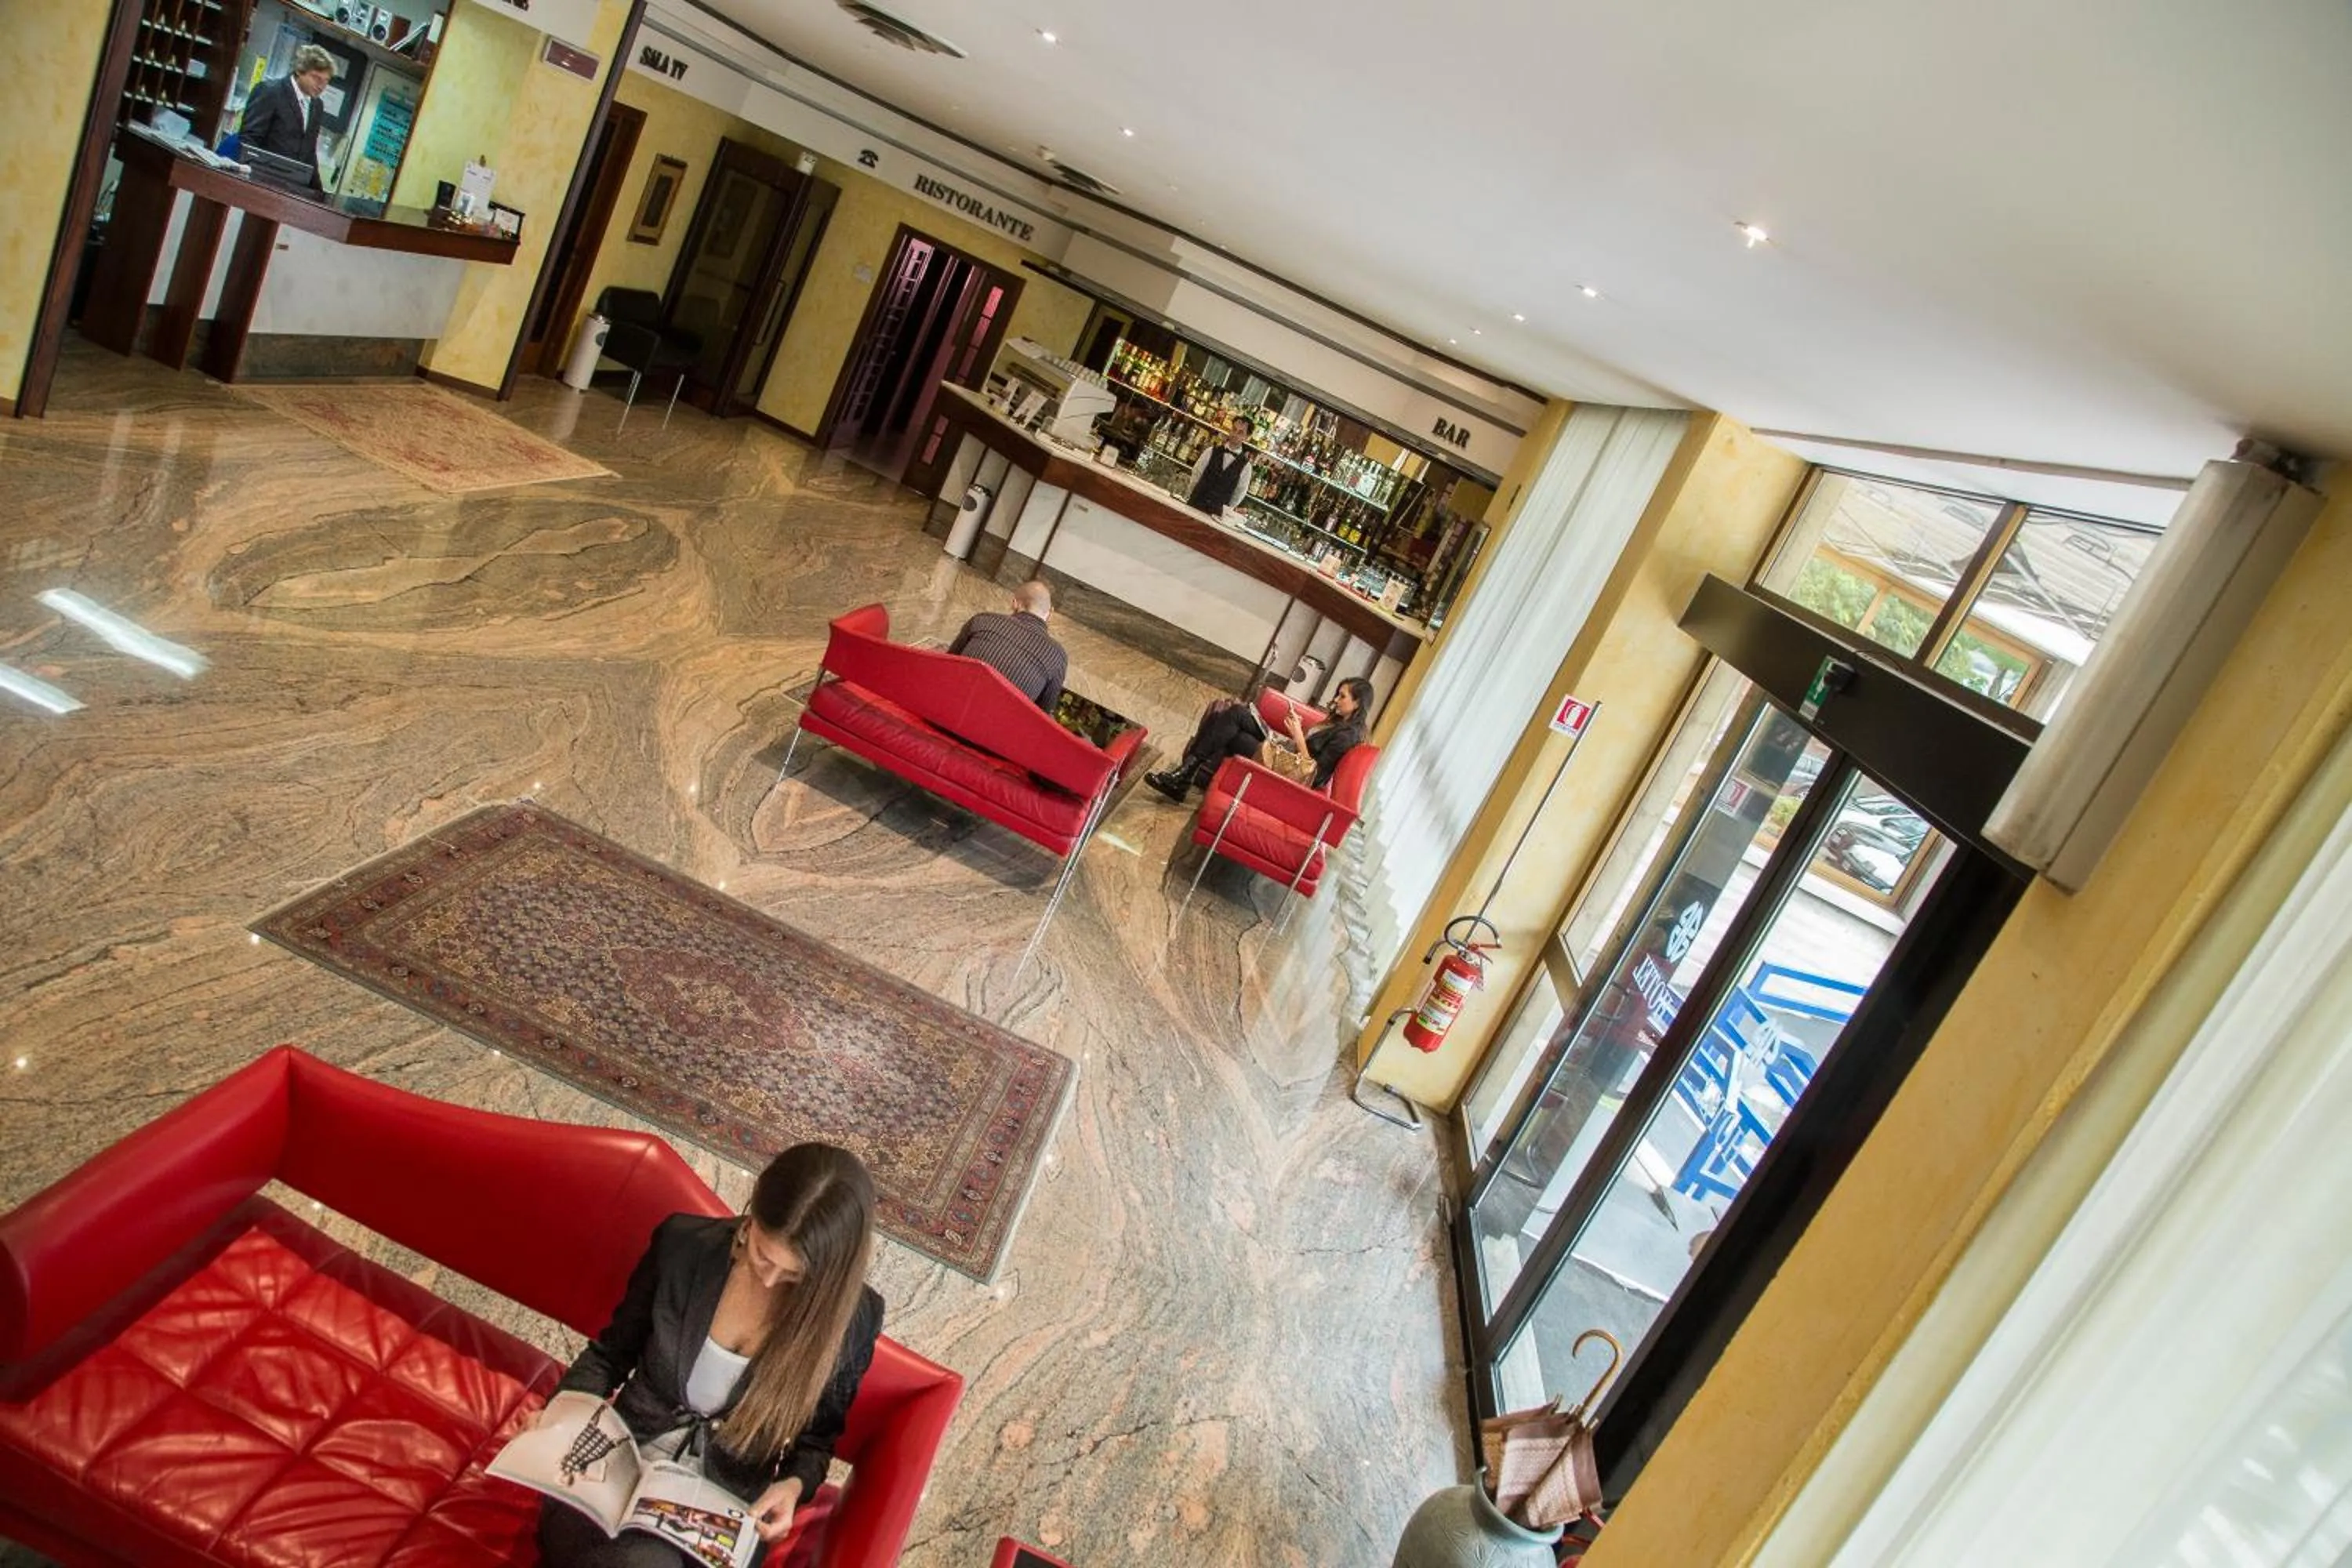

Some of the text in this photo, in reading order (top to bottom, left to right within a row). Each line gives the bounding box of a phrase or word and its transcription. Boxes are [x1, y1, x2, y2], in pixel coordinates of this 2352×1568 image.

[670, 59, 688, 81] TV
[913, 173, 1035, 241] RISTORANTE
[1432, 416, 1471, 448] BAR
